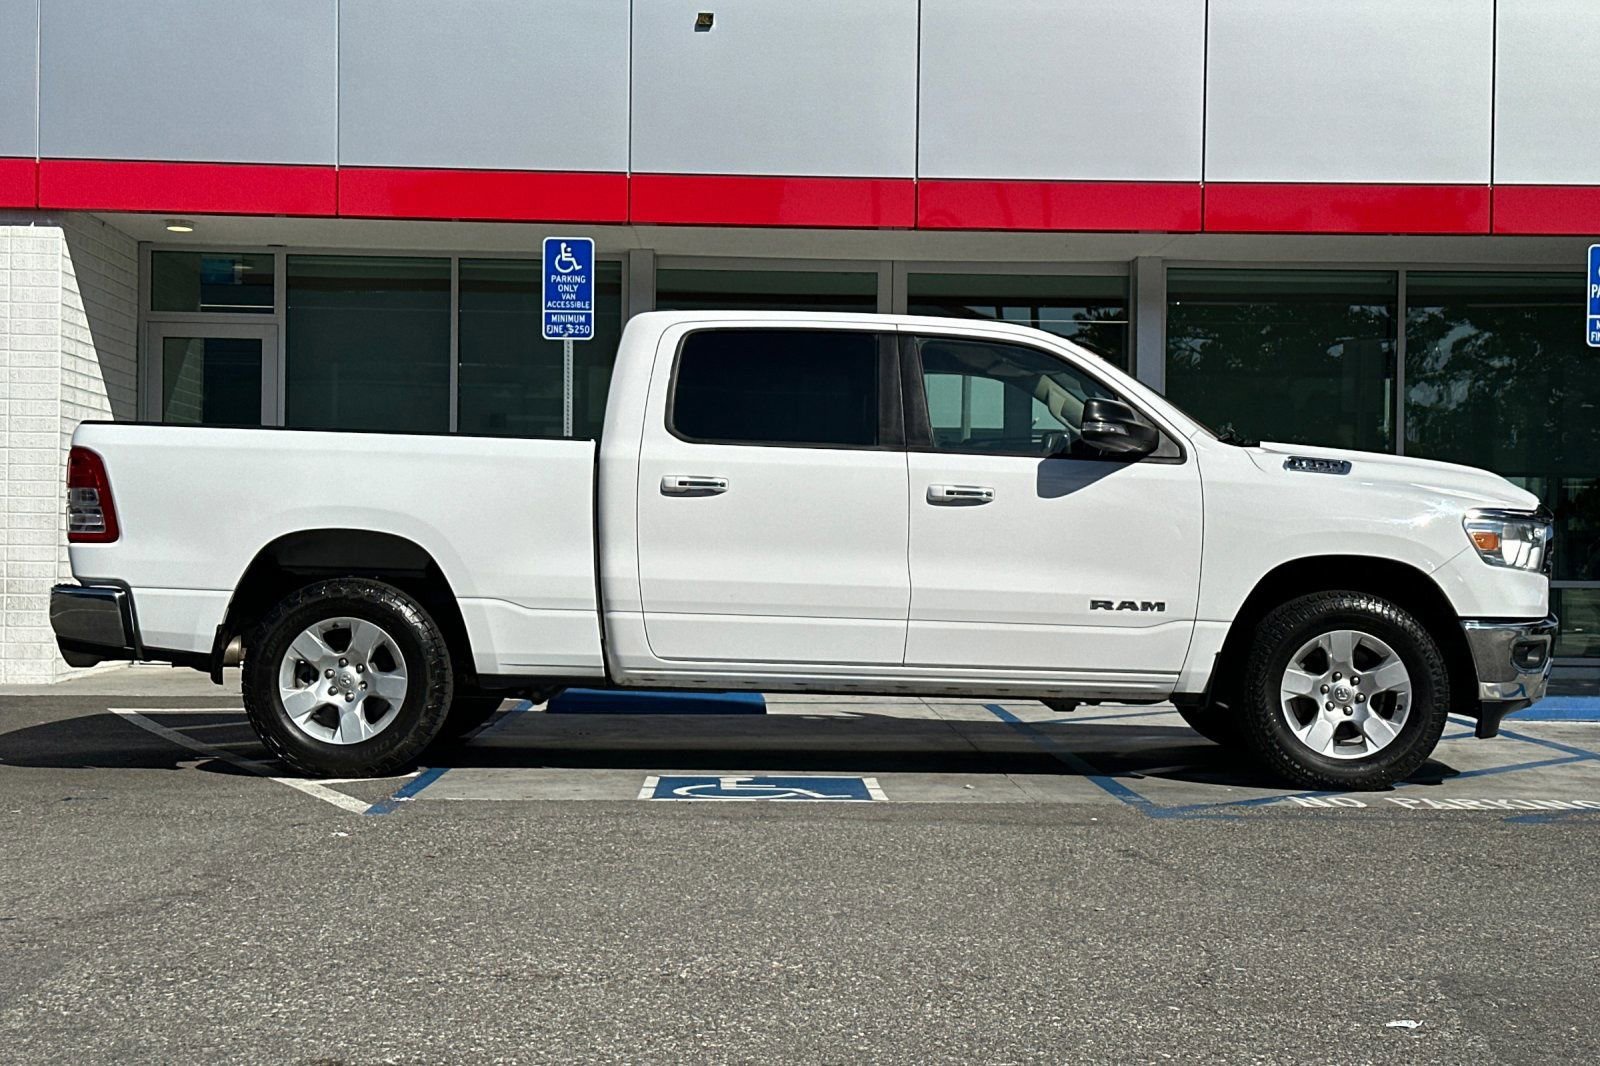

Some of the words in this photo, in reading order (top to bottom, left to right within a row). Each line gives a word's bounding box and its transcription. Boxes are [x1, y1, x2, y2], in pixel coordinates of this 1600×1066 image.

[551, 275, 586, 283] PARKING
[558, 284, 579, 292] ONLY
[547, 301, 590, 309] ACCESSIBLE
[551, 314, 586, 323] MINIMUM
[546, 324, 564, 334] FINE
[1090, 600, 1165, 612] RAM
[1286, 796, 1368, 808] NO
